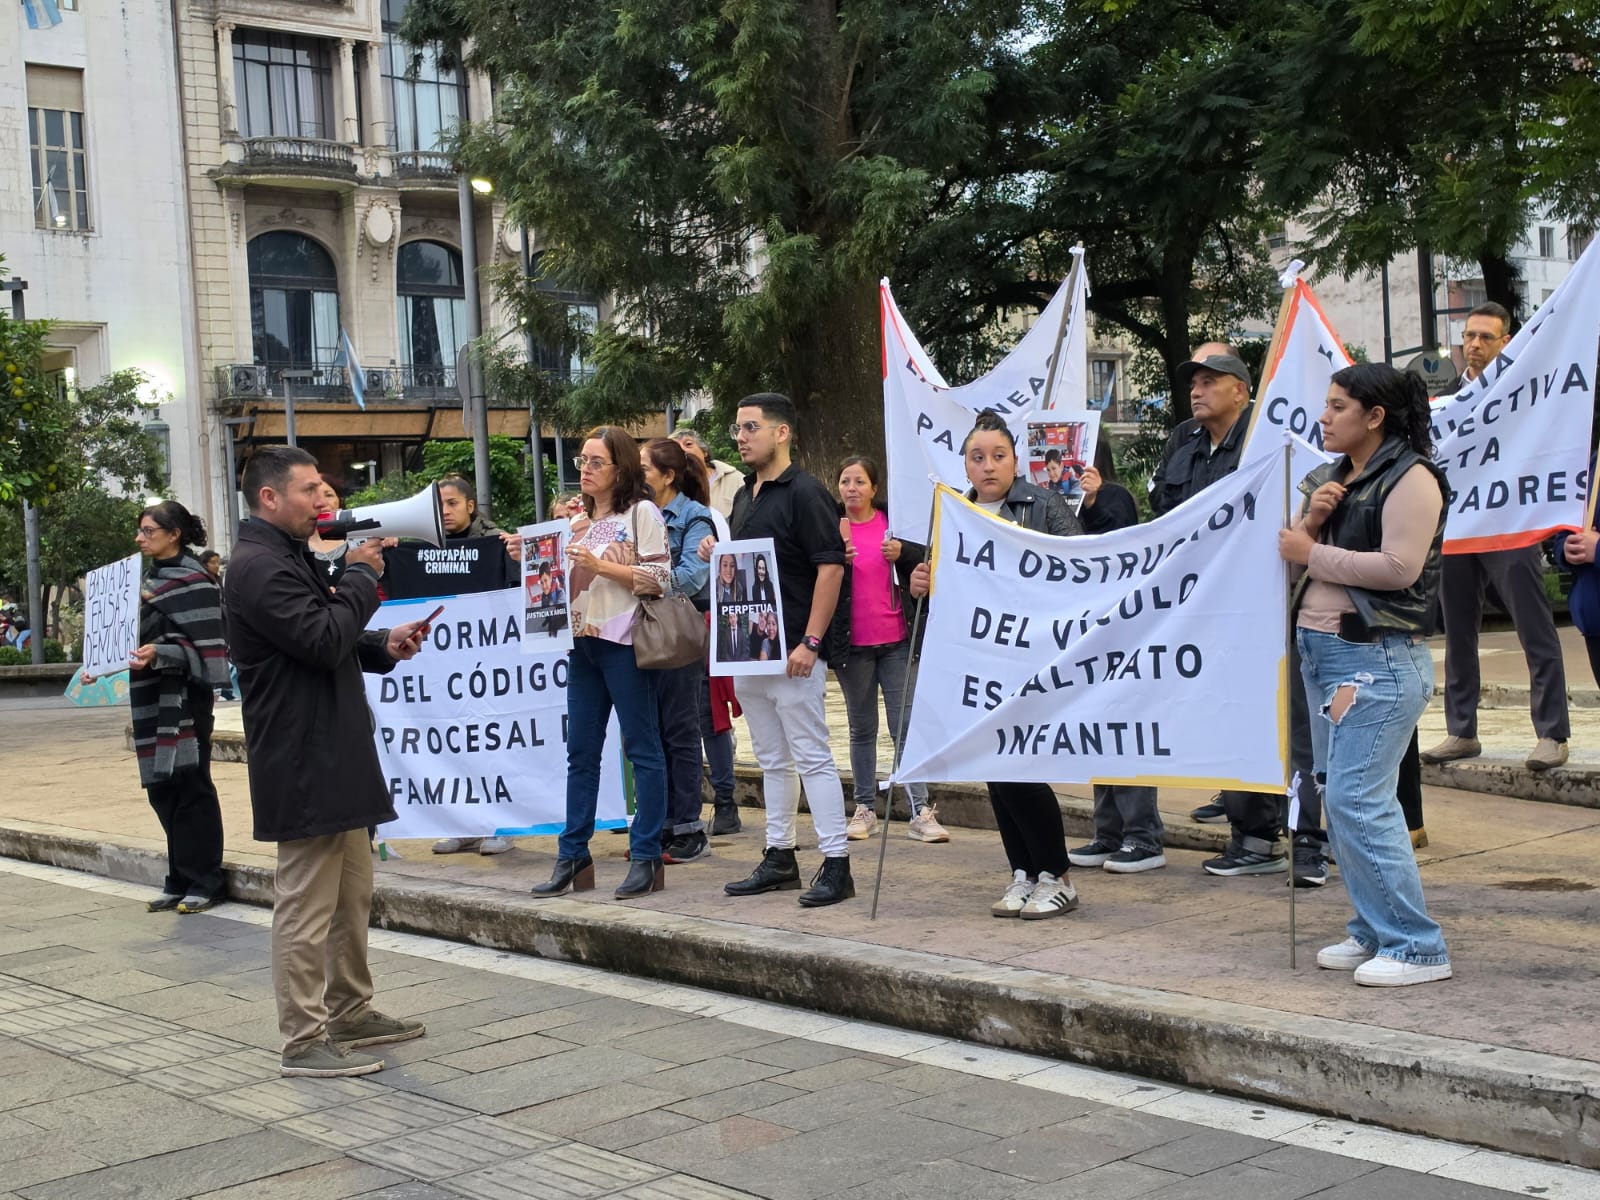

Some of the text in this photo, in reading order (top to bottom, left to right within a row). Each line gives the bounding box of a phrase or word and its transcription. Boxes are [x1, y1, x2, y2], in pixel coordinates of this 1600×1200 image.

[417, 545, 479, 561] #SOYPAPÁNO
[425, 561, 471, 574] CRIMINAL
[956, 532, 995, 570] LA
[89, 558, 130, 600] BASTA DE
[92, 590, 129, 632] FALSAS
[526, 610, 550, 621] JUSTICIA
[722, 603, 773, 616] PERPETUA
[970, 573, 1199, 650] DEL VÍULO
[86, 619, 136, 669] DENUNCIAS
[417, 615, 520, 652] ORMA
[380, 659, 568, 703] DEL CÓDIGO
[962, 644, 1202, 711] ES ALTRATO
[381, 718, 545, 754] PROCESAL
[997, 722, 1171, 756] INFANTIL
[389, 775, 513, 805] FAMILIA
